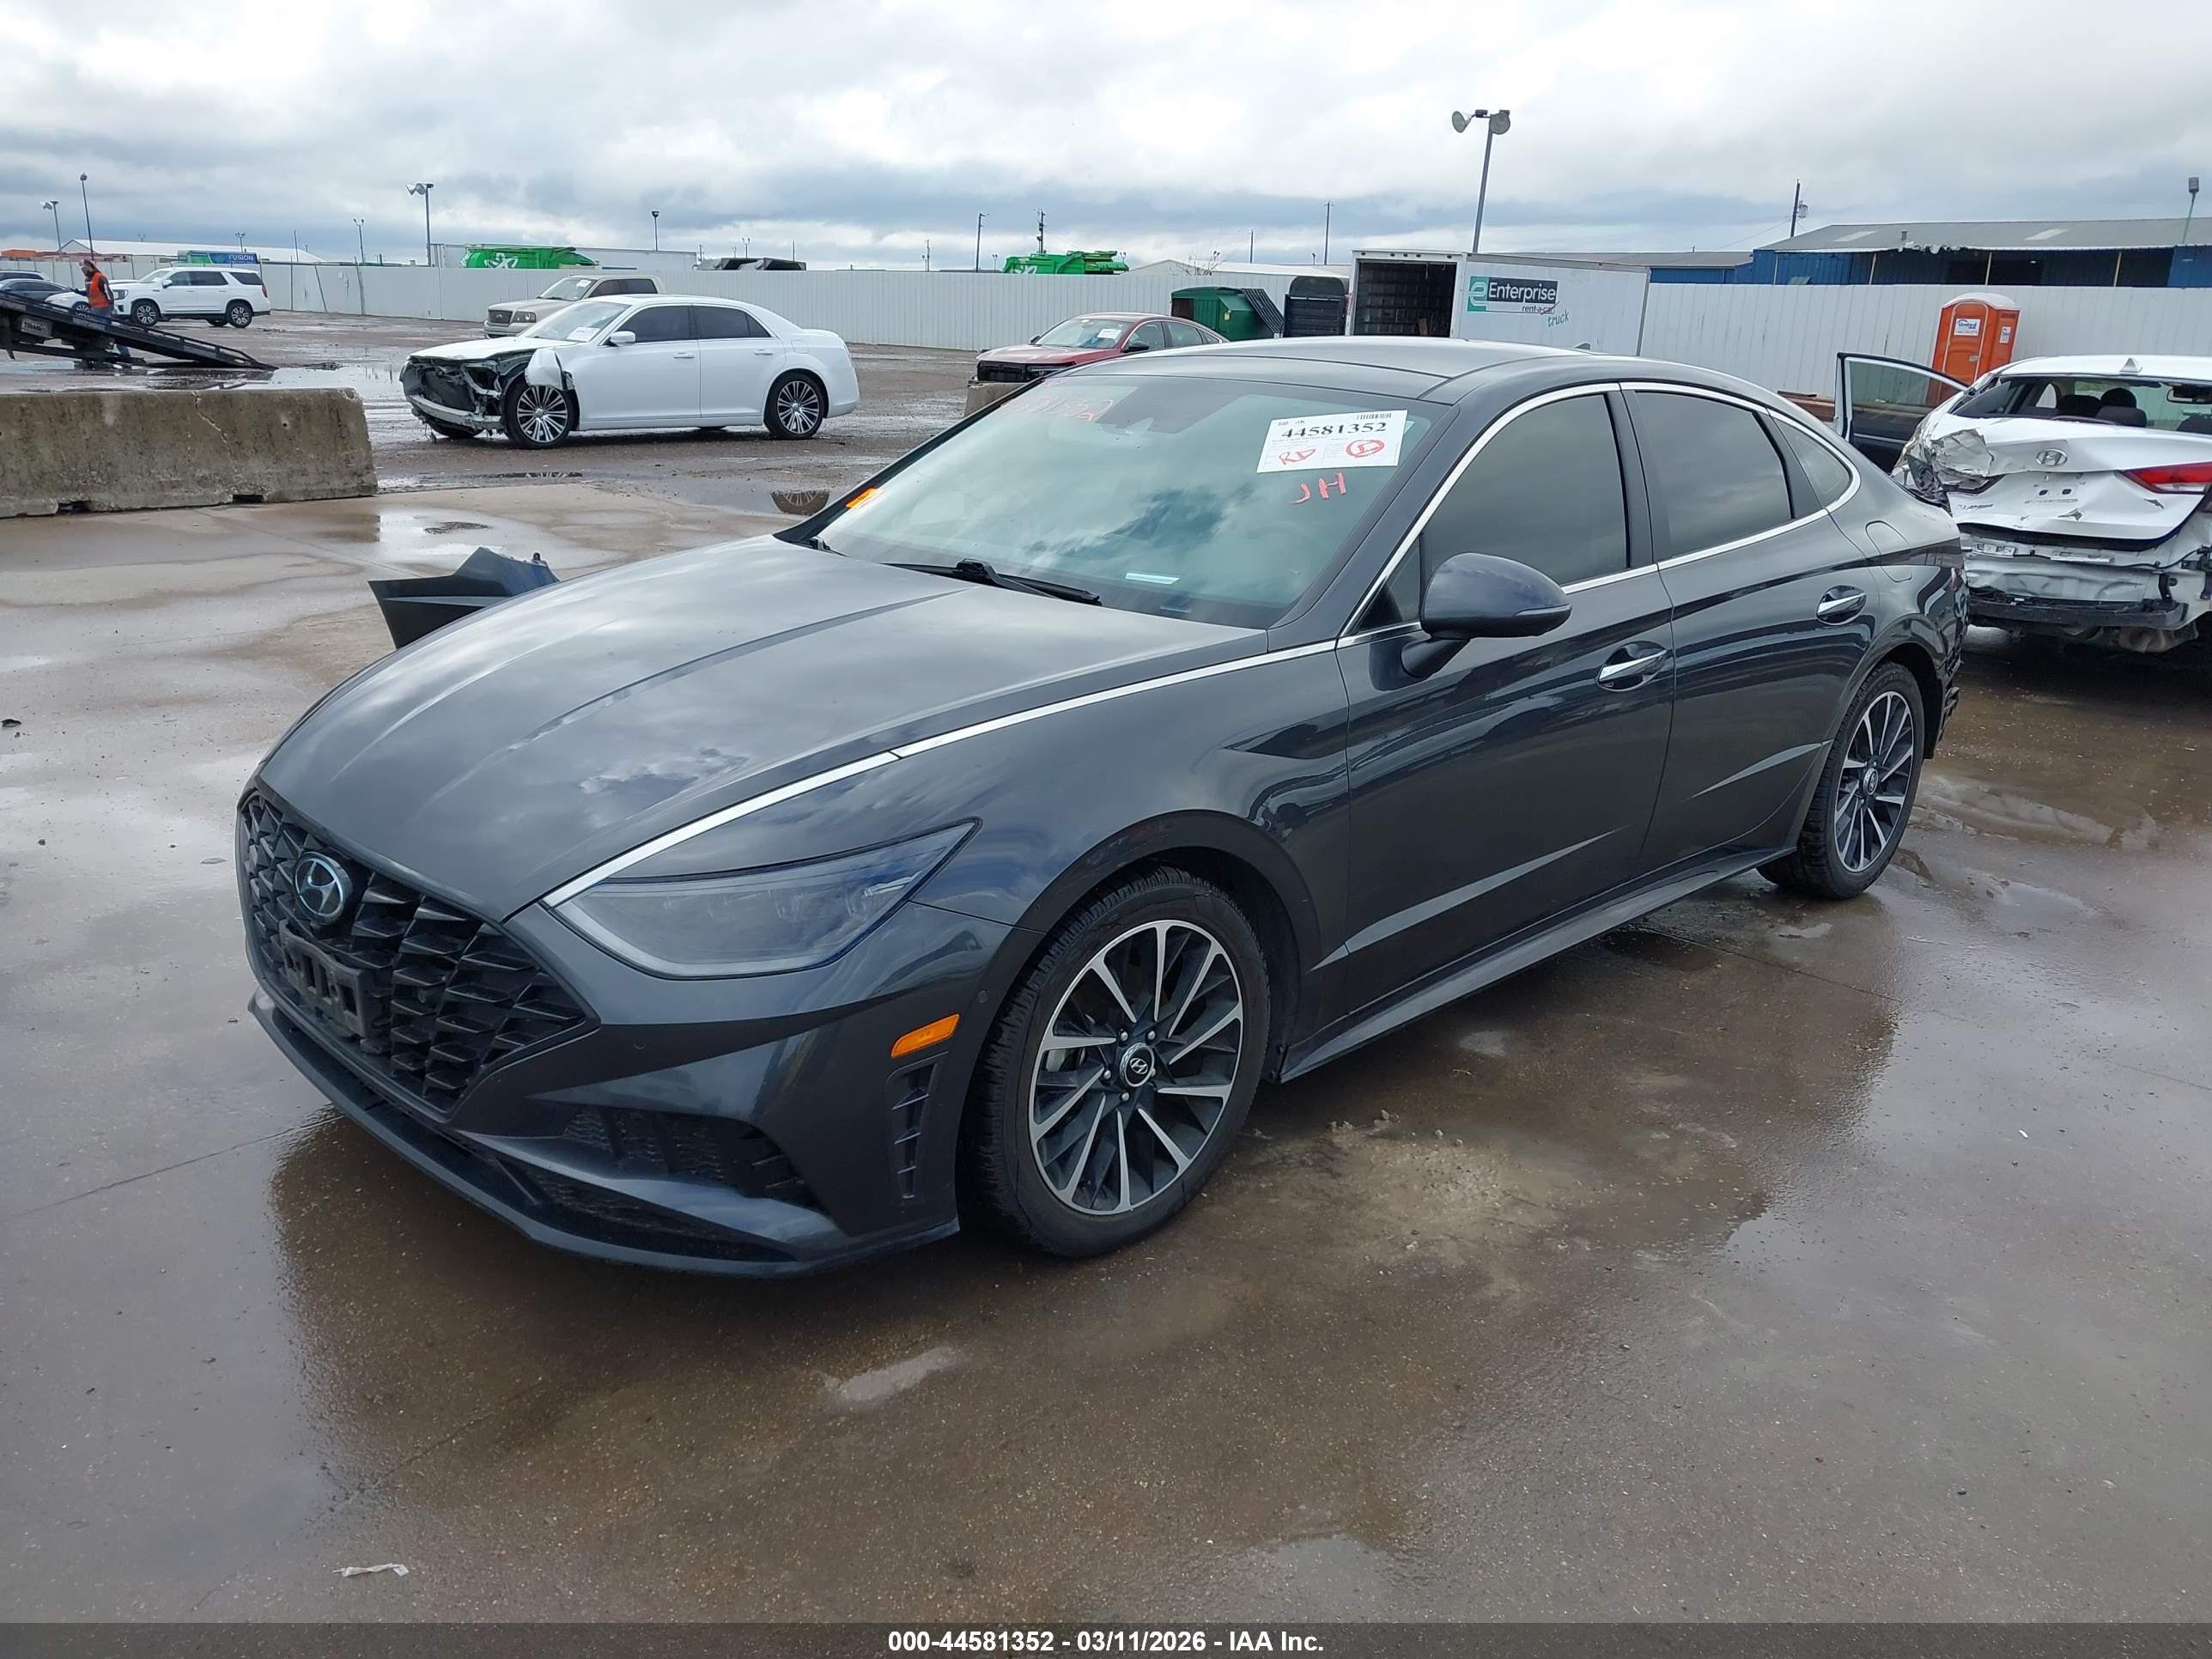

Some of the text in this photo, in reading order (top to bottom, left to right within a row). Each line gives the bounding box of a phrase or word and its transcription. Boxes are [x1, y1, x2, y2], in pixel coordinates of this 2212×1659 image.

[1489, 283, 1556, 303] Enterprise
[1547, 309, 1570, 327] truck
[1280, 422, 1388, 438] 44581352
